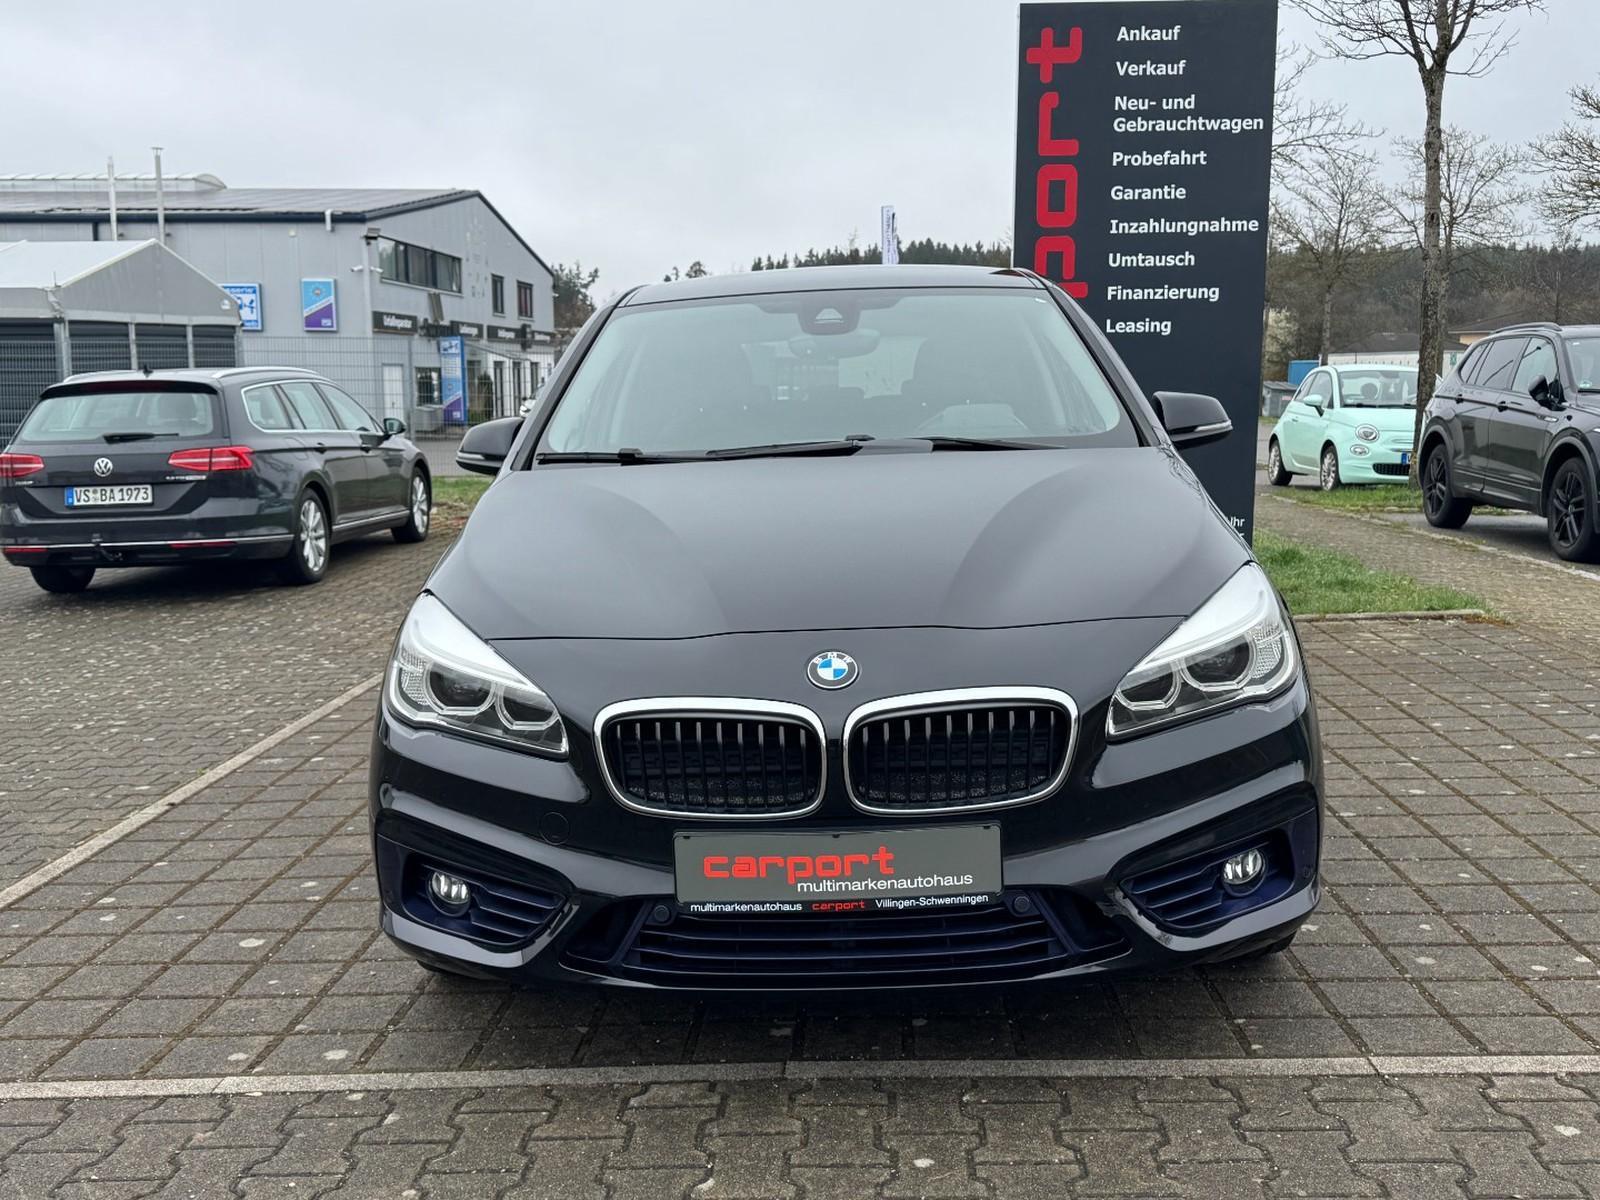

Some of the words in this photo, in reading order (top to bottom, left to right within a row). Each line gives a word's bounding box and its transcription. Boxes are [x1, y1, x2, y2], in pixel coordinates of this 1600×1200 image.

[1116, 24, 1182, 42] Ankauf
[1115, 59, 1187, 77] Verkauf
[1114, 95, 1157, 111] Neu-
[1161, 93, 1196, 110] und
[1112, 115, 1265, 134] Gebrauchtwagen
[1112, 149, 1208, 167] Probefahrt
[1110, 183, 1187, 201] Garantie
[1109, 216, 1260, 237] Inzahlungnahme
[1108, 250, 1196, 268] Umtausch
[1106, 284, 1221, 304] Finanzierung
[1105, 317, 1172, 336] Leasing
[75, 486, 91, 503] VS
[118, 485, 150, 501] 1973
[703, 846, 895, 885] carport
[797, 873, 974, 893] multimarkenautohaus
[690, 901, 803, 913] multimarkenautohaus
[811, 900, 866, 912] carport
[874, 894, 990, 910] Villingen-Schwenningen
